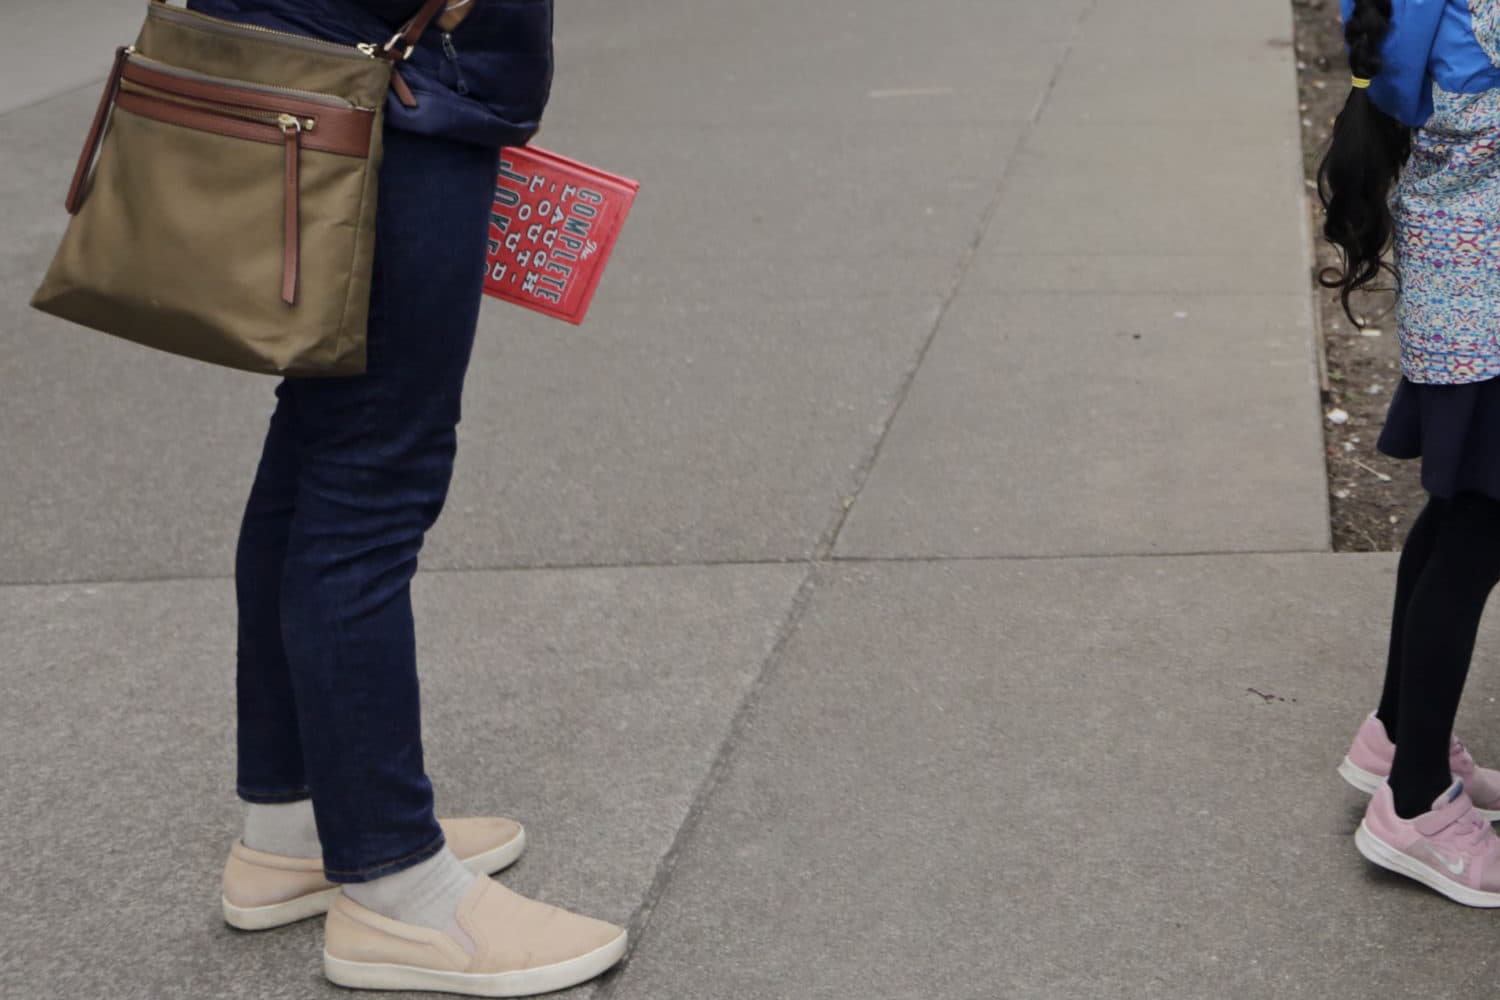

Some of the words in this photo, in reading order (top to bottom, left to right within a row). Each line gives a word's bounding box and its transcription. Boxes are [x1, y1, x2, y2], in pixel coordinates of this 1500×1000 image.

[485, 161, 528, 275] JOK
[492, 175, 545, 280] LOUD
[535, 188, 602, 304] COMPLETE
[580, 239, 598, 260] The
